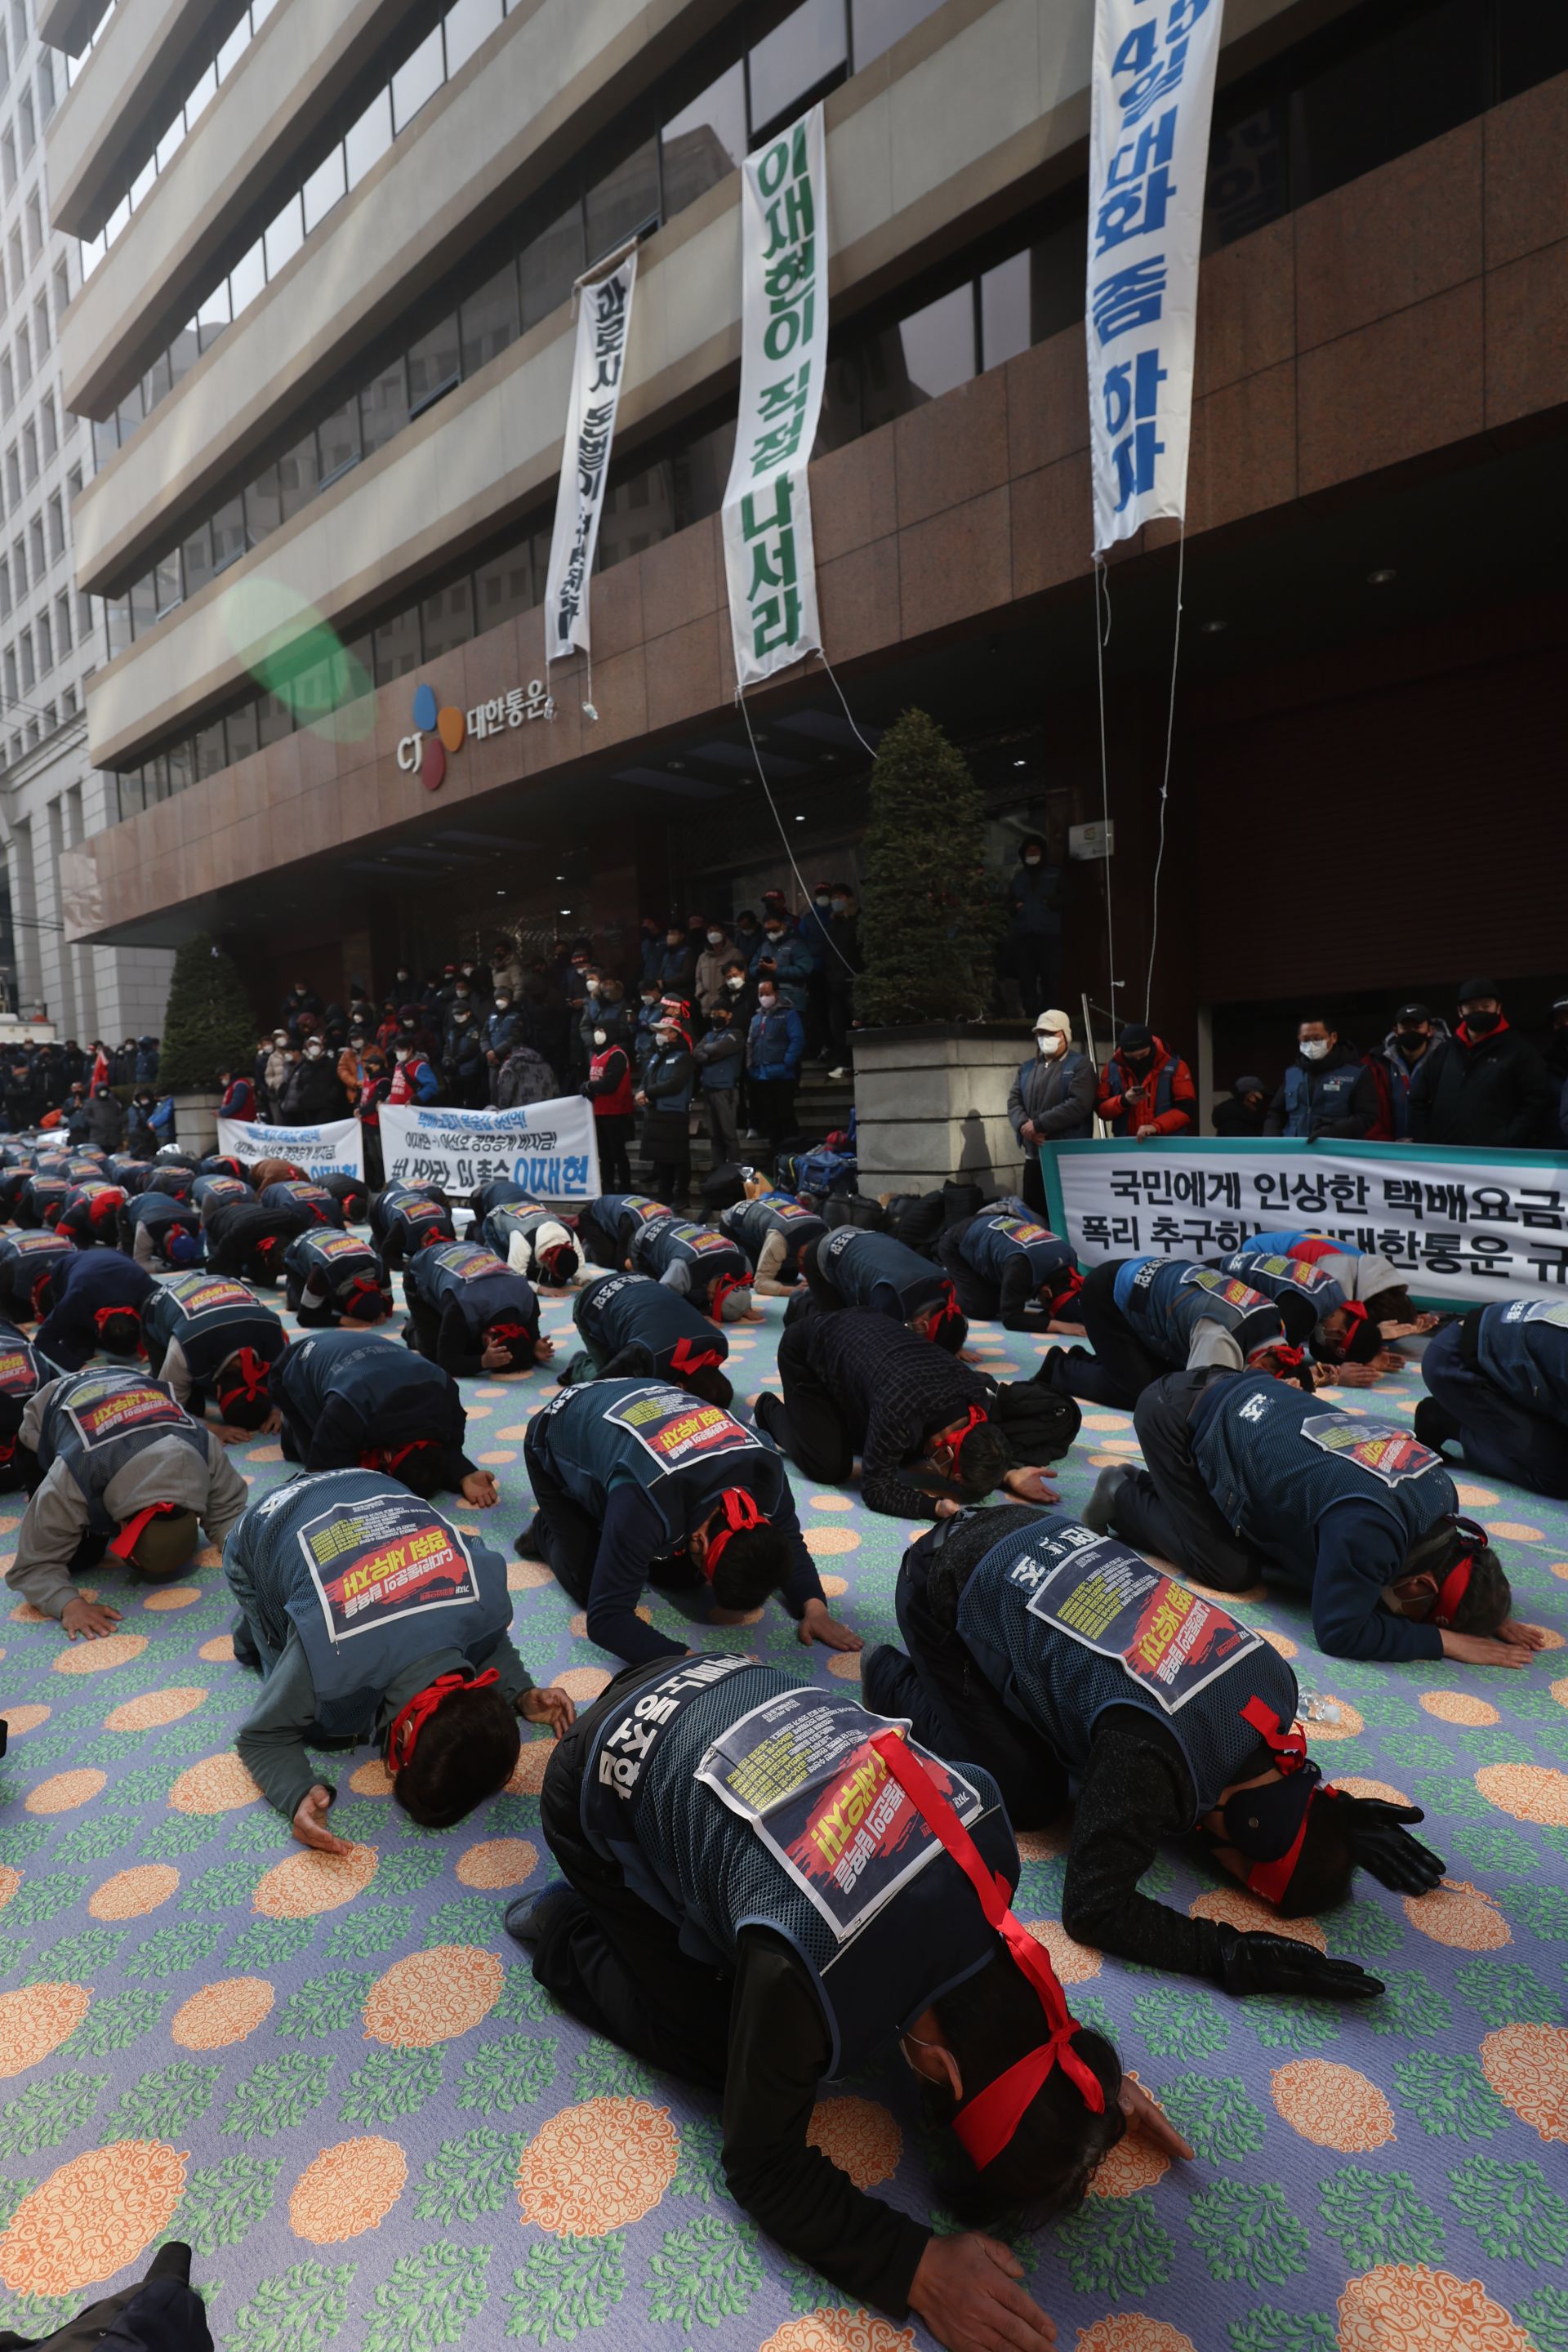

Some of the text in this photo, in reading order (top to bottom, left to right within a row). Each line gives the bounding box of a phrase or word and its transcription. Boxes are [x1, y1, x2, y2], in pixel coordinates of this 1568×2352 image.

[1095, 105, 1177, 258] 대화
[1094, 254, 1168, 346] 좀
[577, 275, 627, 501] 과로사 돈벌이
[742, 121, 815, 660] 이재현이 직접 나서라
[1102, 348, 1167, 513] 하자
[396, 679, 546, 773] CJ 대한통운
[514, 1155, 589, 1195] 이재현
[1110, 1169, 1566, 1230] 국민에게 인상한 택배요금
[1082, 1215, 1140, 1251] 폭리
[1151, 1216, 1263, 1255] 추구하
[1304, 1227, 1513, 1278] 대한통운
[658, 1416, 699, 1450] 세우자!
[342, 1546, 406, 1598] 세우자!
[409, 1530, 447, 1561] 멈춰
[343, 1548, 453, 1619] CJ대한통운의 탐욕을
[1136, 1601, 1182, 1667] 세우자!
[1154, 1643, 1186, 1686] 탐욕을
[808, 1757, 881, 1865] 세우자!
[952, 1791, 969, 1808] 가자!
[831, 1827, 877, 1895] 탐욕을
